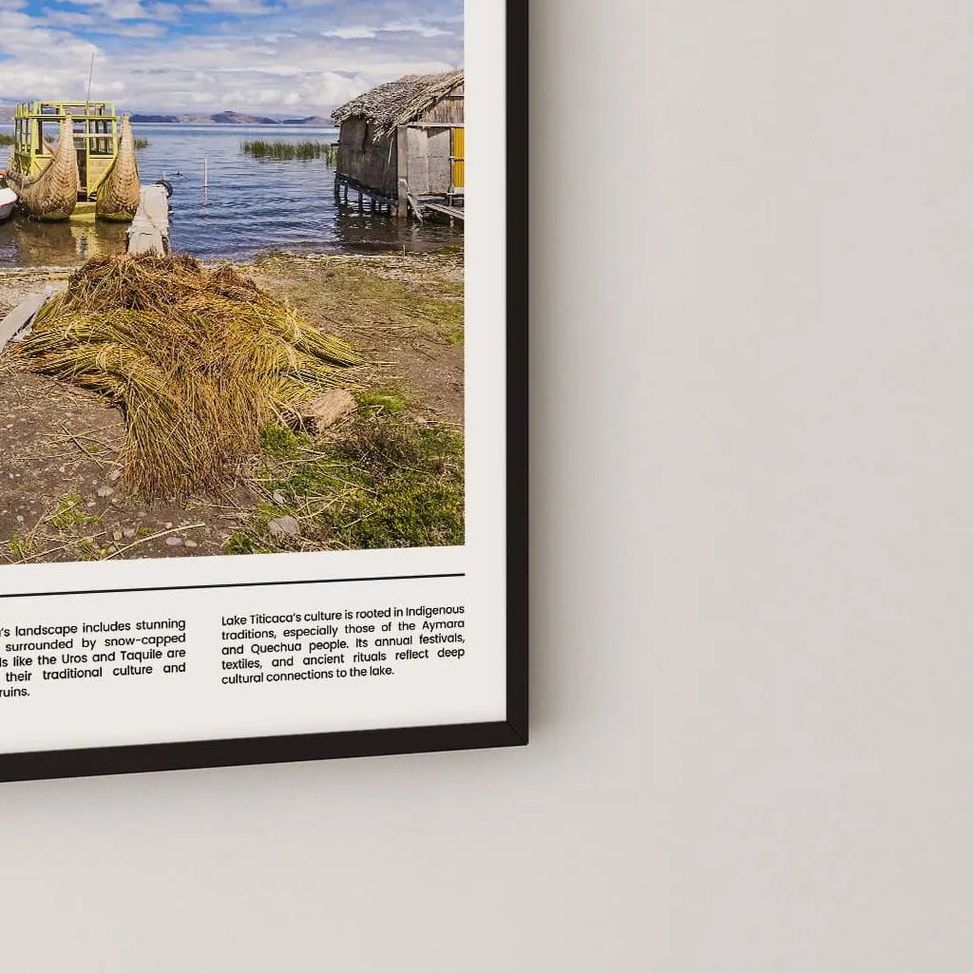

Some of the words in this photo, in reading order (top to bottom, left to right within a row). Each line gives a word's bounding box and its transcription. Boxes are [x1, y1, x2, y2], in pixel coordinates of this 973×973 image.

[222, 615, 247, 626] Lake
[304, 611, 342, 622] culture
[344, 609, 353, 620] is
[356, 607, 391, 619] rooted
[394, 607, 403, 617] in
[406, 605, 465, 619] Indigenous
[15, 625, 78, 637] landscape
[82, 621, 131, 633] includes
[136, 618, 186, 631] stunning
[222, 628, 277, 640] traditions,
[283, 625, 338, 640] especially
[344, 624, 375, 634] those
[381, 621, 392, 632] of
[398, 621, 416, 631] the
[422, 620, 465, 633] Aymara
[5, 638, 73, 652] surrounded
[82, 638, 97, 651] by
[104, 632, 186, 648] snow-capped
[221, 644, 244, 655] and
[251, 642, 302, 655] Quechua
[309, 639, 349, 654] people.
[356, 638, 368, 648] Its
[374, 635, 413, 647] annual
[419, 633, 465, 644] festivals,
[13, 655, 33, 667] like
[37, 655, 57, 665] the
[61, 653, 88, 664] Uros
[92, 651, 116, 662] and
[120, 648, 163, 663] Taquile
[167, 649, 186, 658] are
[221, 658, 263, 670] textiles,
[271, 656, 294, 667] and
[302, 653, 345, 666] ancient
[353, 651, 387, 663] rituals
[395, 649, 429, 660] reflect
[437, 647, 465, 659] deep
[5, 670, 32, 682] their
[42, 666, 102, 680] traditional
[112, 665, 153, 676] culture
[163, 662, 186, 673] and
[221, 672, 264, 685] cultural
[266, 669, 334, 682] connections
[336, 668, 347, 678] to
[349, 667, 367, 677] the
[369, 665, 395, 676] lake.
